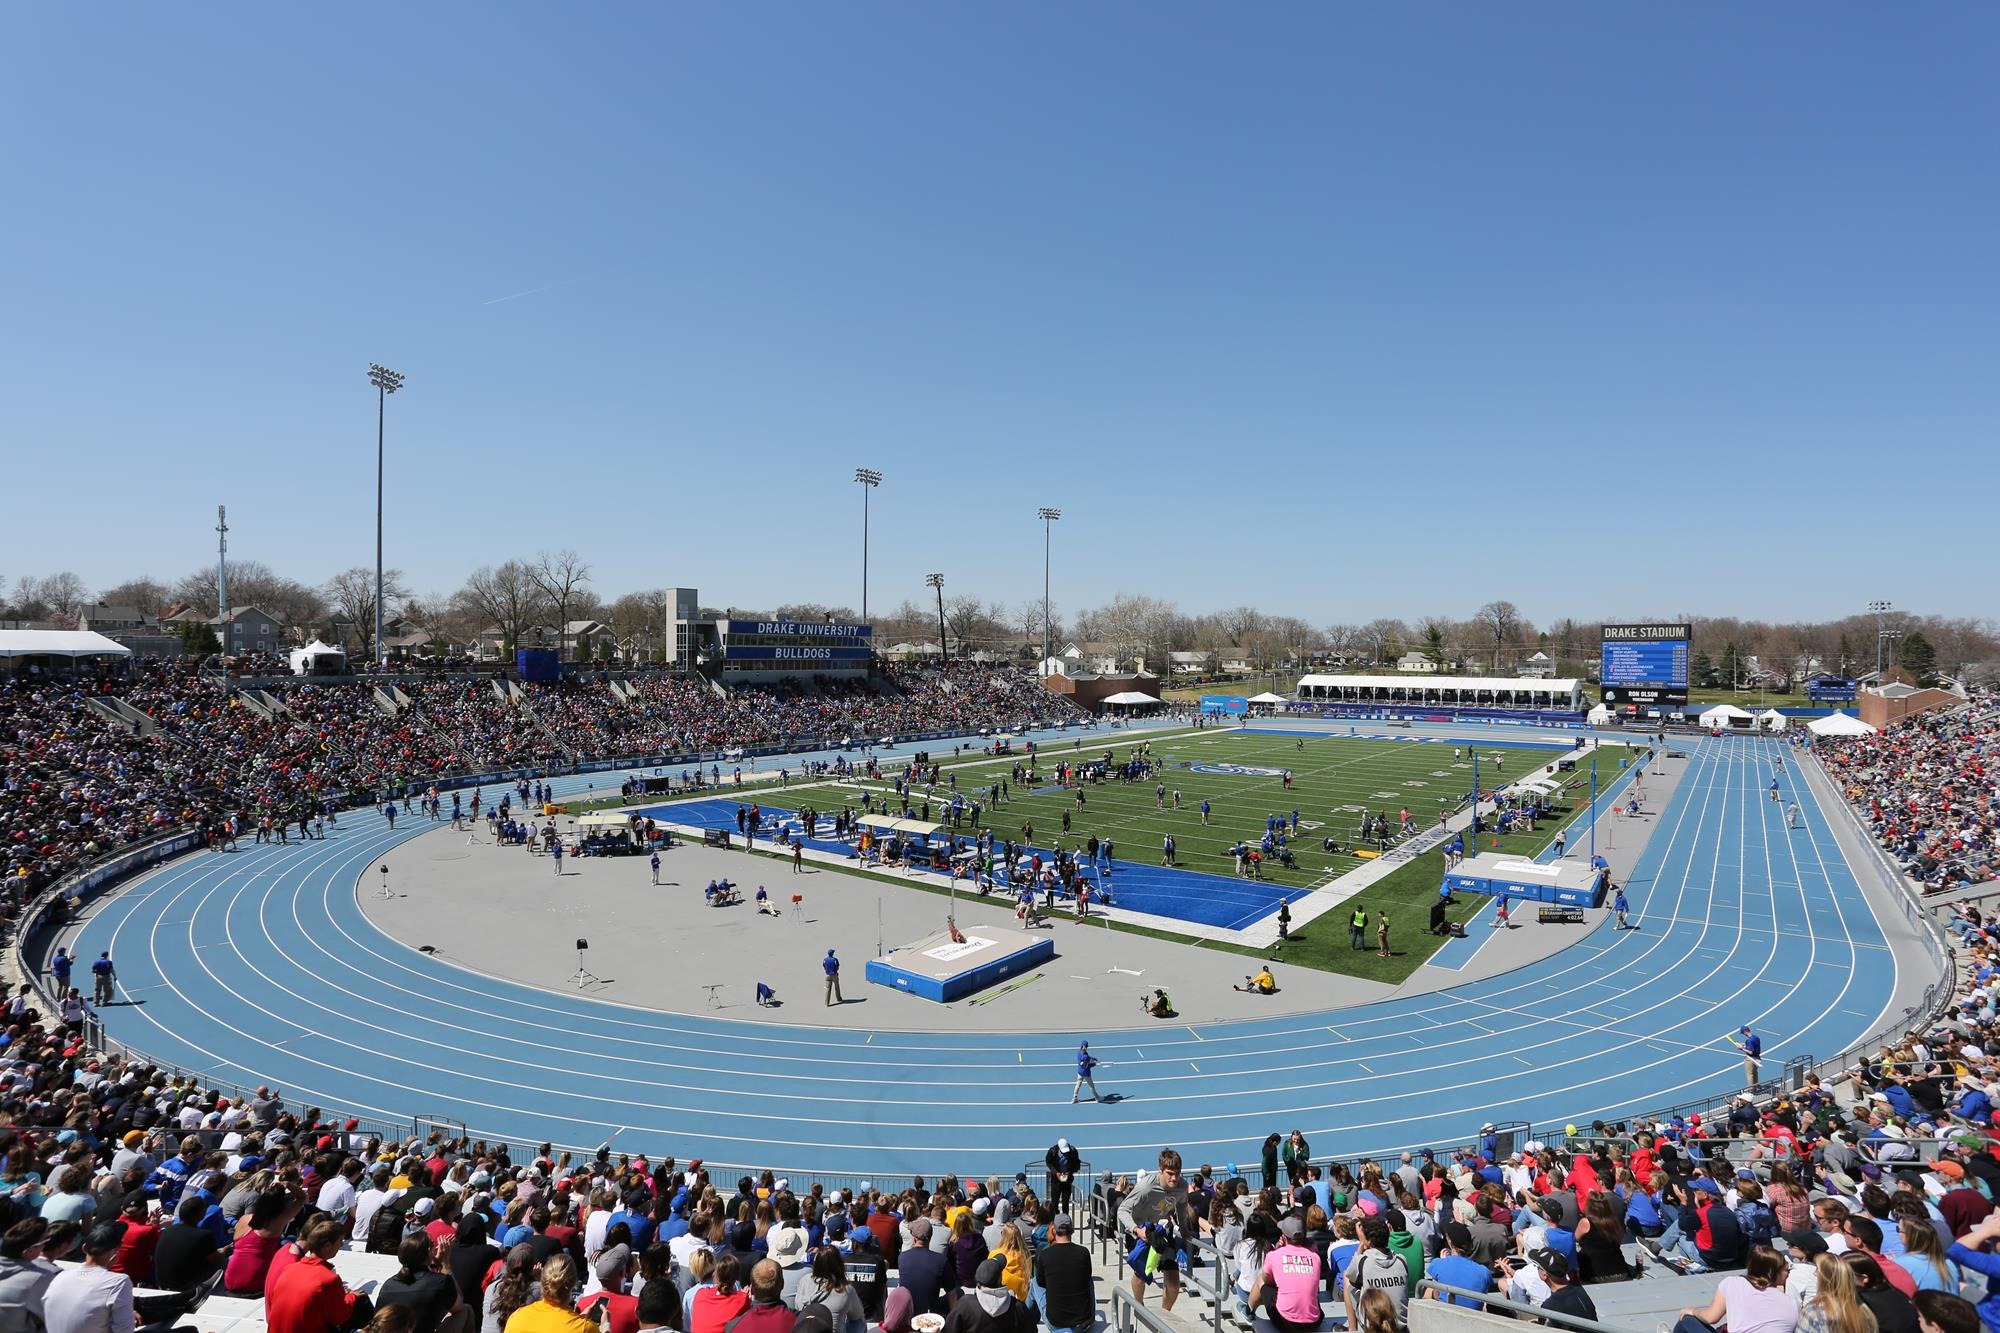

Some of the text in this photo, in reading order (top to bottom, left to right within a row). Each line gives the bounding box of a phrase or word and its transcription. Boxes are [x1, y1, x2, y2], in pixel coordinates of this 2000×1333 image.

[758, 622, 859, 636] DRAKE UNIVERSITY
[1604, 627, 1685, 638] DRAKE STADIUM
[775, 647, 831, 659] BULLDOGS
[1508, 885, 1526, 893] GILL
[1559, 893, 1577, 901] GILL
[1282, 1264, 1314, 1275] CANCER
[857, 1273, 876, 1282] TEAM
[1366, 1276, 1406, 1289] VONDRA
